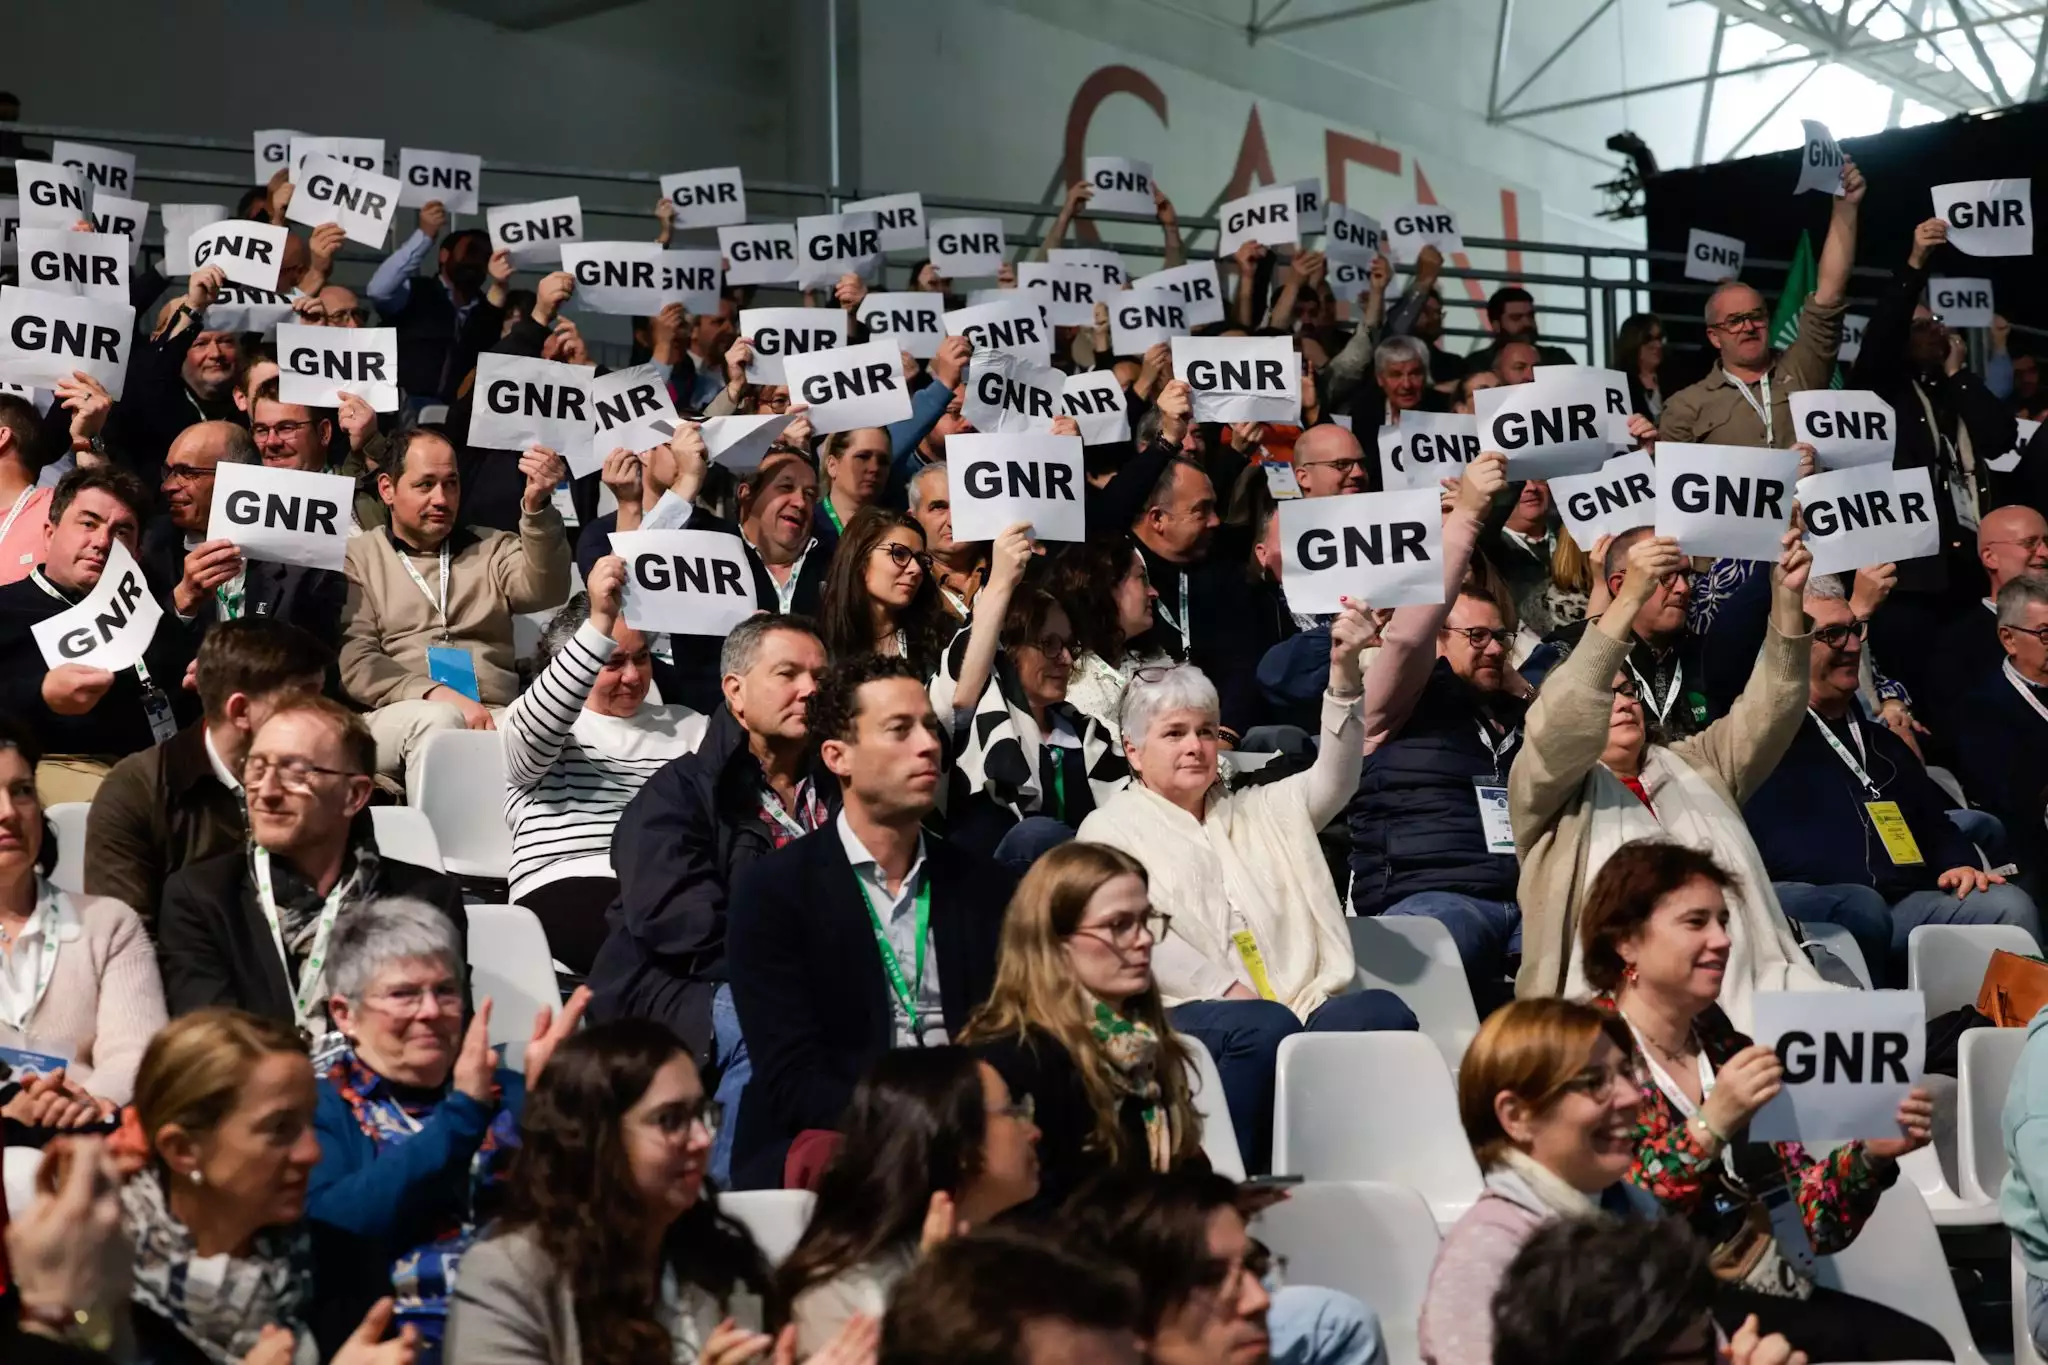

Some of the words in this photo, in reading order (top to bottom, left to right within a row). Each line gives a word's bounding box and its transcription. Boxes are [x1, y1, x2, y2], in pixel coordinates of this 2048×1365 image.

[408, 165, 472, 191] GNR
[1095, 170, 1149, 194] GNR
[29, 180, 85, 211] GN
[307, 175, 386, 220] GNR
[672, 183, 737, 207] GNR
[91, 213, 136, 242] NR
[500, 215, 575, 243] GNR
[877, 208, 917, 230] NR
[1228, 203, 1289, 233] GNR
[1394, 216, 1455, 235] GNR
[1948, 200, 2025, 228] GNR
[195, 236, 273, 266] GNR
[730, 240, 794, 262] GNR
[809, 230, 878, 261] GNR
[938, 233, 1001, 255] GNR
[1333, 220, 1378, 251] GNR
[31, 251, 120, 285] GNR
[1694, 244, 1740, 267] GNR
[575, 260, 655, 288] GNR
[1336, 265, 1372, 283] GN
[1154, 278, 1214, 303] NR
[1937, 290, 1989, 308] GNR
[865, 310, 938, 334] GNR
[1119, 306, 1186, 330] GNR
[11, 315, 121, 363] GNR
[754, 328, 837, 355] GNR
[962, 318, 1040, 350] GNR
[289, 347, 386, 383] GNR
[1186, 360, 1286, 391] GNR
[802, 363, 897, 401] GNR
[978, 372, 1052, 418] GNR
[487, 379, 587, 421] GNR
[595, 384, 663, 434] NR
[1062, 388, 1120, 415] NR
[1492, 404, 1599, 449] GNR
[1806, 410, 1888, 441] GNR
[1411, 433, 1480, 463] GNR
[964, 461, 1075, 500] GNR
[1671, 473, 1784, 519] GNR
[225, 489, 338, 535] GNR
[1568, 473, 1656, 521] GNR
[1803, 490, 1897, 537] GNR
[1296, 521, 1430, 571] GNR
[634, 553, 747, 597] GNR
[58, 570, 143, 658] GNR
[1776, 1031, 1909, 1084] GNR
